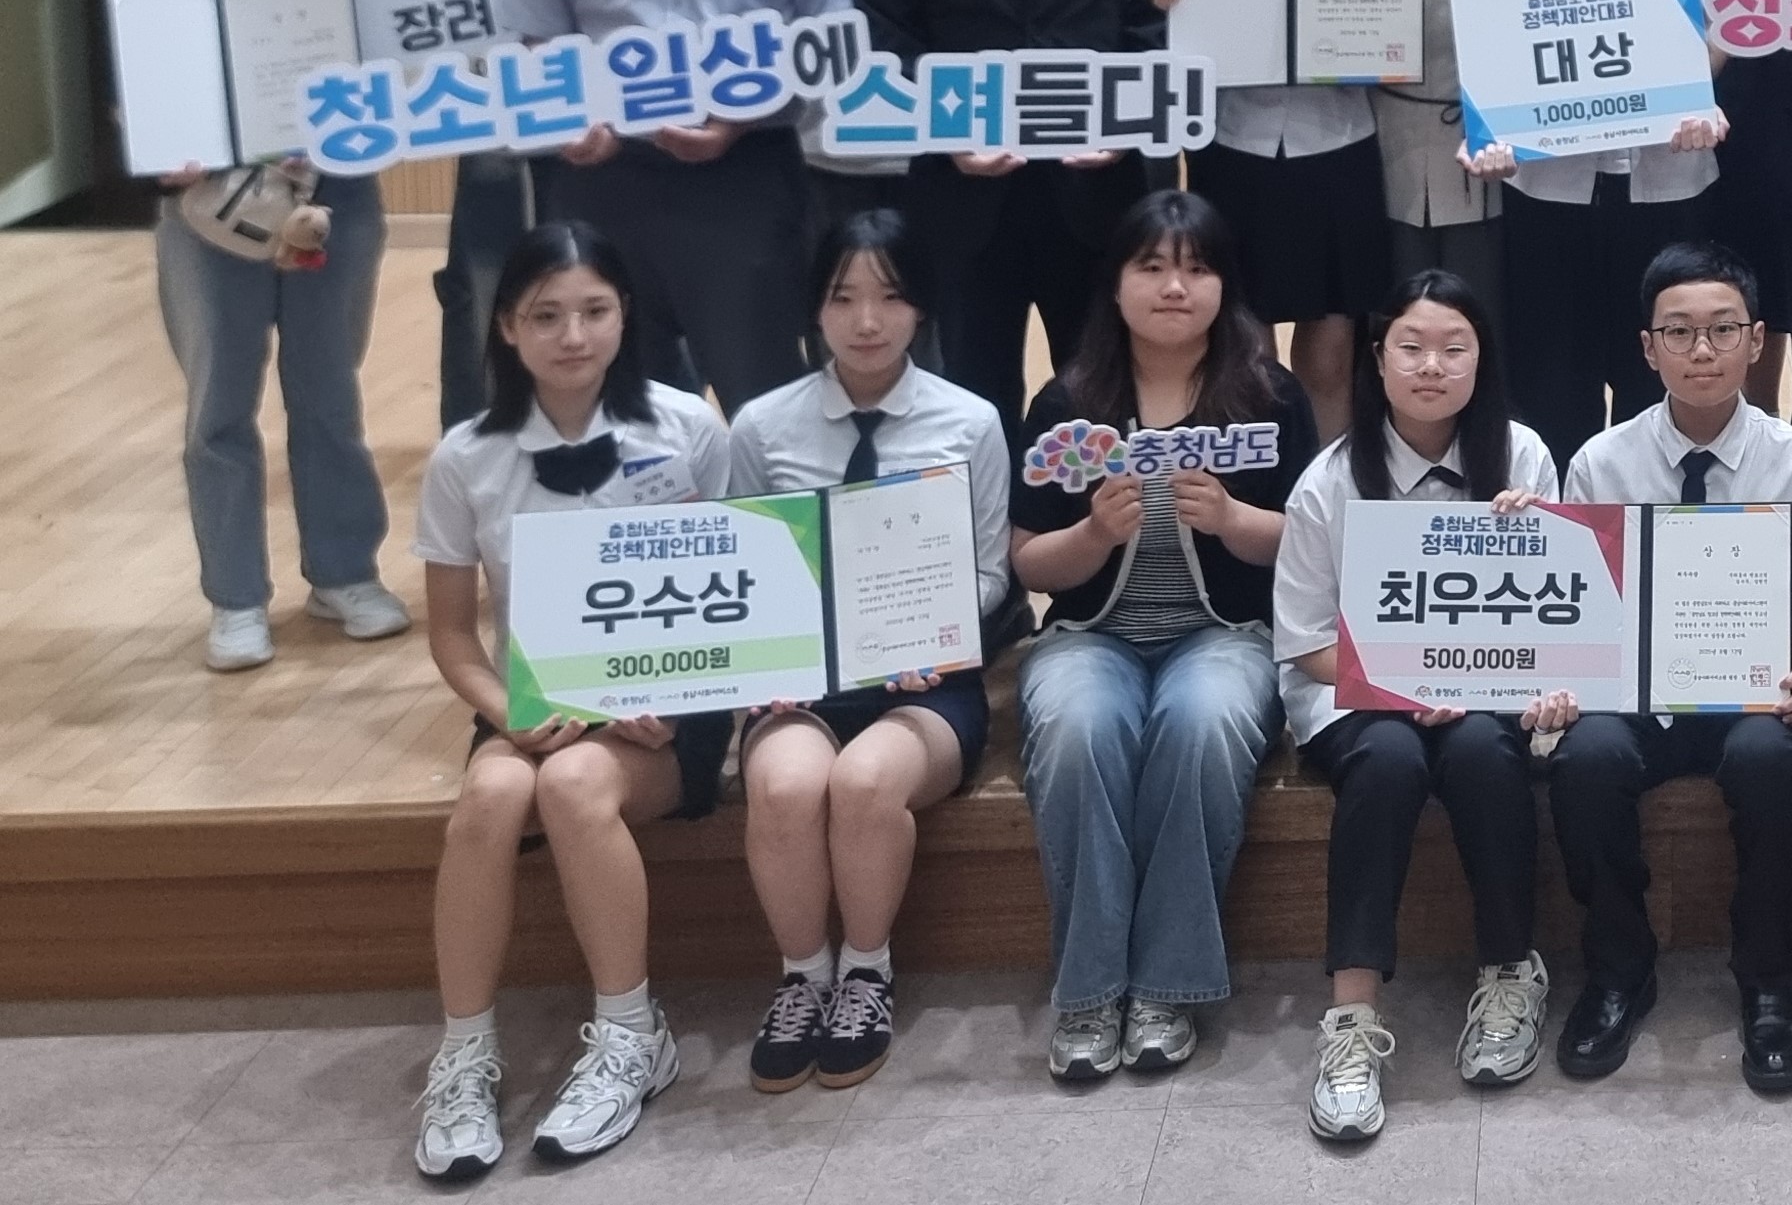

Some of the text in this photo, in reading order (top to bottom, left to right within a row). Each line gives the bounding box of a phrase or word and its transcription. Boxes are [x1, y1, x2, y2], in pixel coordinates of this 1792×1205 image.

[1522, 0, 1635, 30] 정책제안대회
[308, 47, 589, 163] 청소년
[608, 22, 860, 124] 일상에
[836, 62, 1205, 146] 스며들다!
[1533, 93, 1648, 126] 1,000,000원
[1130, 429, 1275, 475] 충청남도
[609, 515, 730, 539] 충청남도 청소년
[1430, 516, 1541, 533] 충청남도 청소년
[599, 533, 738, 564] 정책제안대회
[1421, 534, 1547, 557] 정책제안대회
[581, 569, 756, 634] 우수상
[1377, 571, 1588, 625] 최우수상
[606, 646, 731, 678] 300,000원
[1423, 648, 1536, 672] 500,000원
